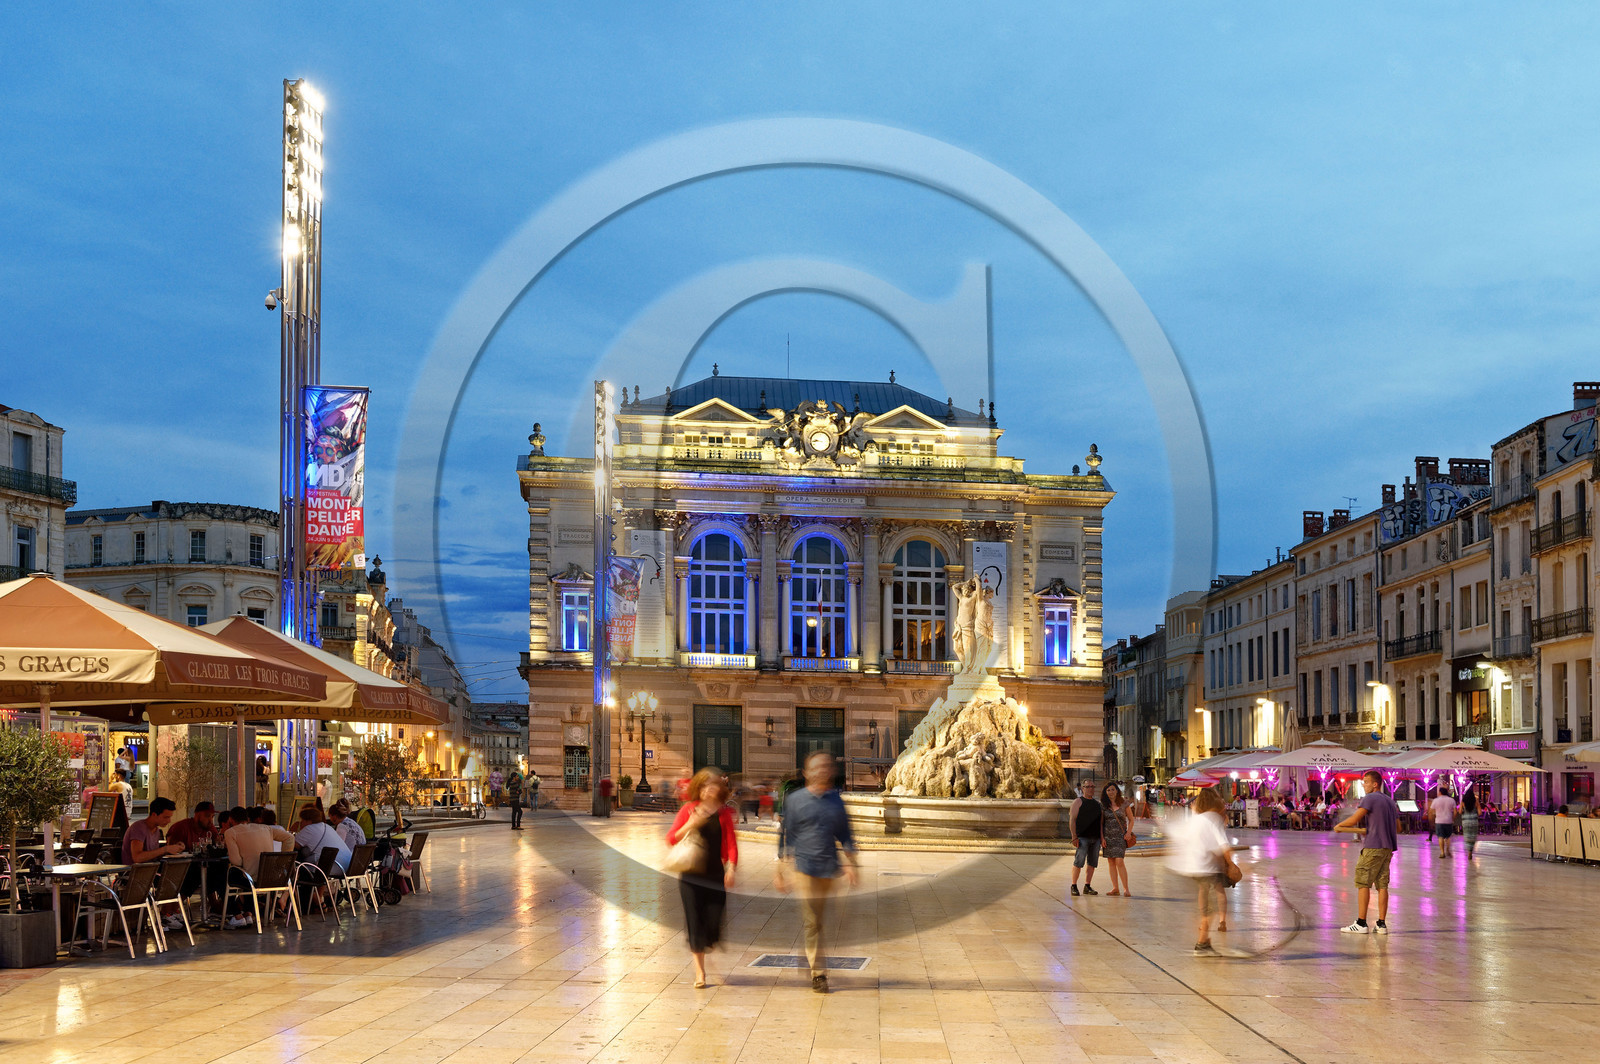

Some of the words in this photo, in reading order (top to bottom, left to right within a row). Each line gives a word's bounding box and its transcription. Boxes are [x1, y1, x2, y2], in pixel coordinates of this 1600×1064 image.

[308, 497, 351, 510] MONT
[308, 523, 354, 536] DANSE
[18, 655, 109, 674] GRACES
[187, 661, 230, 680] GLACIER
[234, 664, 252, 681] LES
[255, 667, 279, 685] TROIS
[281, 671, 310, 691] GRACES
[370, 691, 394, 705] GLACIER
[407, 693, 422, 708] TROIS
[422, 698, 440, 715] GRACES
